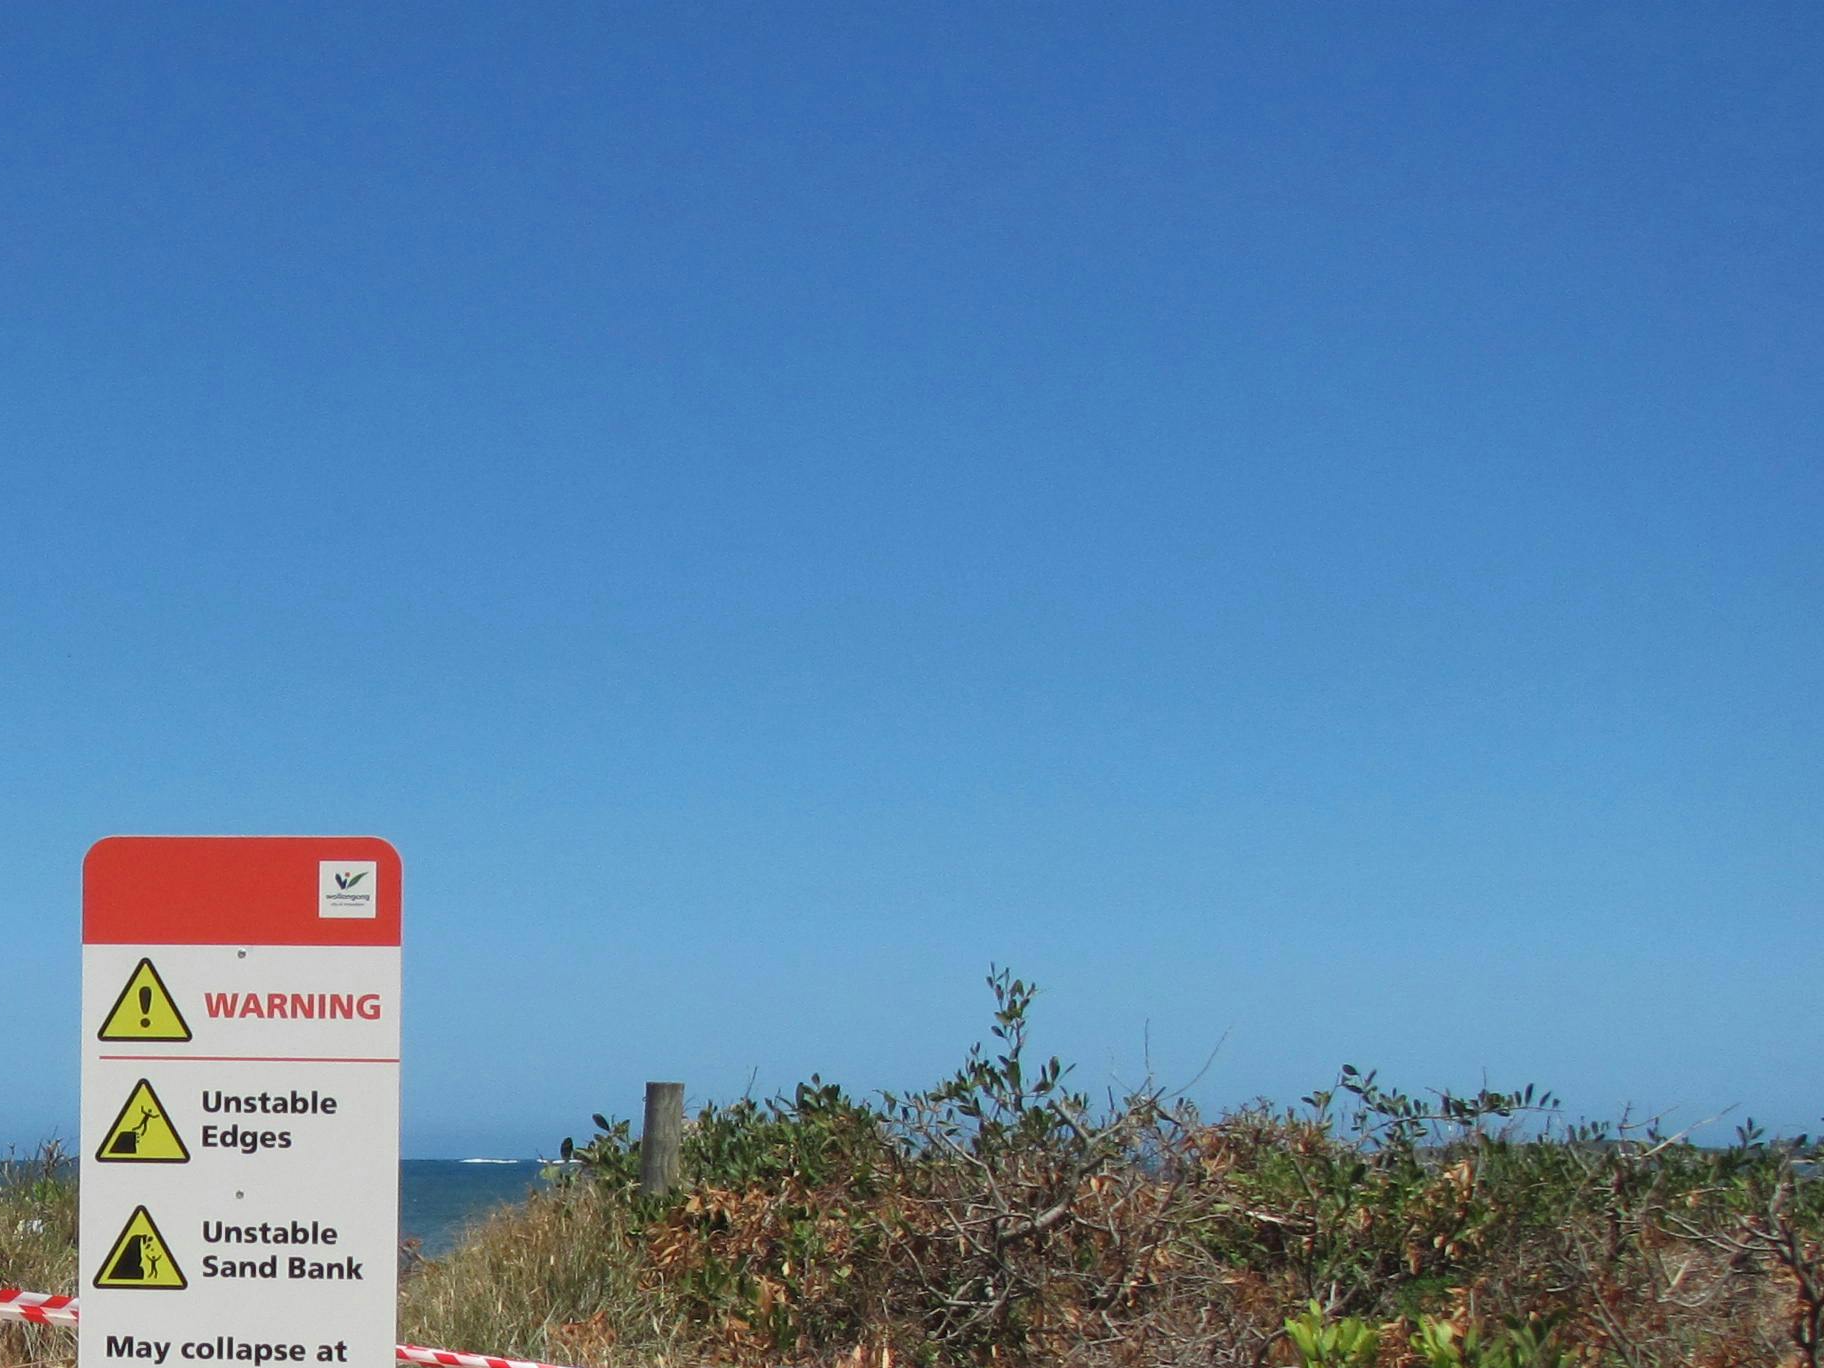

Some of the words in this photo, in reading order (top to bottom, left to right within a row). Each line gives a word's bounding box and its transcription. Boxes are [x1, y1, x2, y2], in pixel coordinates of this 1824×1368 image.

[204, 993, 381, 1019] WARNING
[202, 1091, 337, 1114] Unstable
[202, 1125, 292, 1154] Edges
[203, 1221, 338, 1244] Unstable
[202, 1255, 277, 1278] Sand
[288, 1257, 363, 1279] Bank
[106, 1336, 171, 1364] May
[181, 1337, 306, 1365] collapse
[316, 1341, 347, 1362] at
